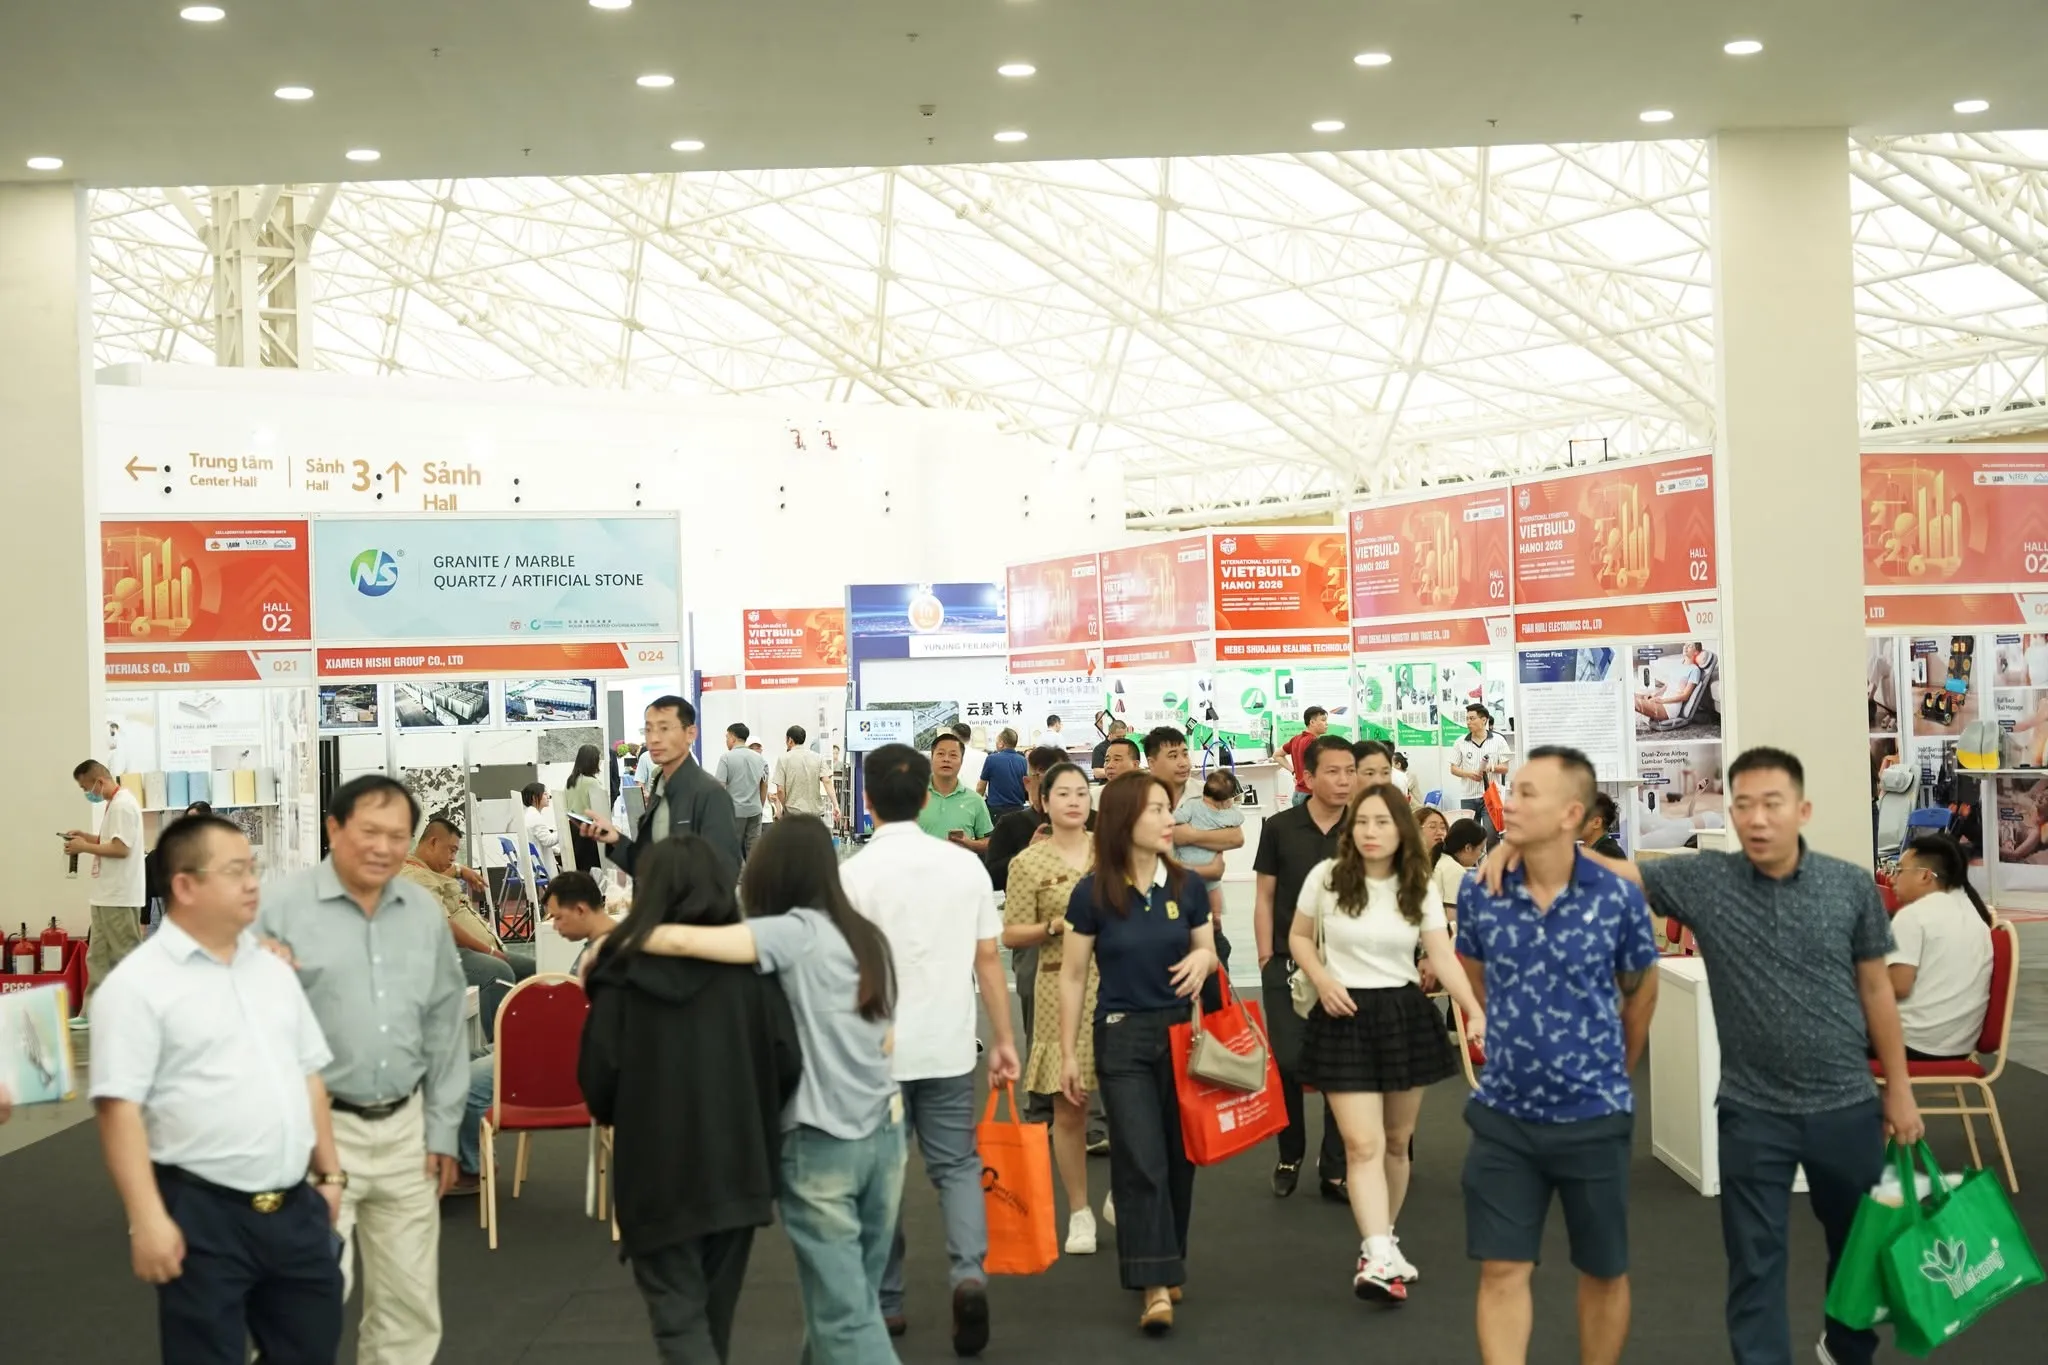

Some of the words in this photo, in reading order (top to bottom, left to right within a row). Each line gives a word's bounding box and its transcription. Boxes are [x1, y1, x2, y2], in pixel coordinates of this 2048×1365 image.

[189, 453, 238, 472] Trung
[242, 453, 273, 470] tâm
[306, 457, 344, 474] Sảnh
[352, 459, 371, 492] 3
[423, 461, 481, 486] Sảnh
[190, 475, 230, 486] Center
[234, 476, 257, 487] Hall
[306, 480, 329, 491] Hall
[424, 494, 457, 511] Hall
[1520, 519, 1575, 539] VIETBUILD
[1355, 542, 1400, 559] VIETBUILD
[1520, 542, 1544, 554] HANOI
[1690, 548, 1708, 558] HALL
[433, 555, 500, 568] GRANITE
[503, 555, 510, 569] /
[515, 555, 576, 568] MARBLE
[1355, 562, 1374, 572] HANOI
[2025, 553, 2048, 574] 02
[1221, 566, 1302, 578] VIETBUILD
[1490, 570, 1504, 579] HALL
[1690, 560, 1708, 580] 02
[434, 574, 496, 591] QUARTZ
[501, 574, 508, 588] /
[512, 574, 590, 587] ARTIFICIAL
[595, 574, 644, 586] STONE
[1221, 580, 1256, 590] HANOI
[1258, 580, 1283, 589] 2026
[1490, 582, 1504, 598] 02
[263, 602, 292, 612] HALL
[1870, 607, 1885, 618] LTD
[262, 614, 292, 632] 02
[1696, 612, 1714, 624] 020
[1548, 620, 1581, 633] ELECTRONICS
[1593, 618, 1602, 630] LTD
[749, 629, 804, 638] VIETBUILD
[1496, 626, 1508, 638] 019
[924, 642, 960, 651] YUNJING
[1224, 645, 1244, 654] HEBEI
[1282, 644, 1312, 653] SEALING
[326, 658, 363, 670] XIAMEN
[366, 657, 392, 668] NISHI
[394, 656, 426, 667] GROUP
[428, 656, 446, 667] CO.,
[448, 655, 464, 666] LTD
[638, 651, 664, 662] 024
[152, 663, 170, 674] CO.,
[174, 663, 190, 673] LTD
[273, 660, 298, 672] 021
[966, 701, 1022, 716] 云景飞林
[1671, 750, 1688, 758] Airbag
[1664, 758, 1686, 766] Support
